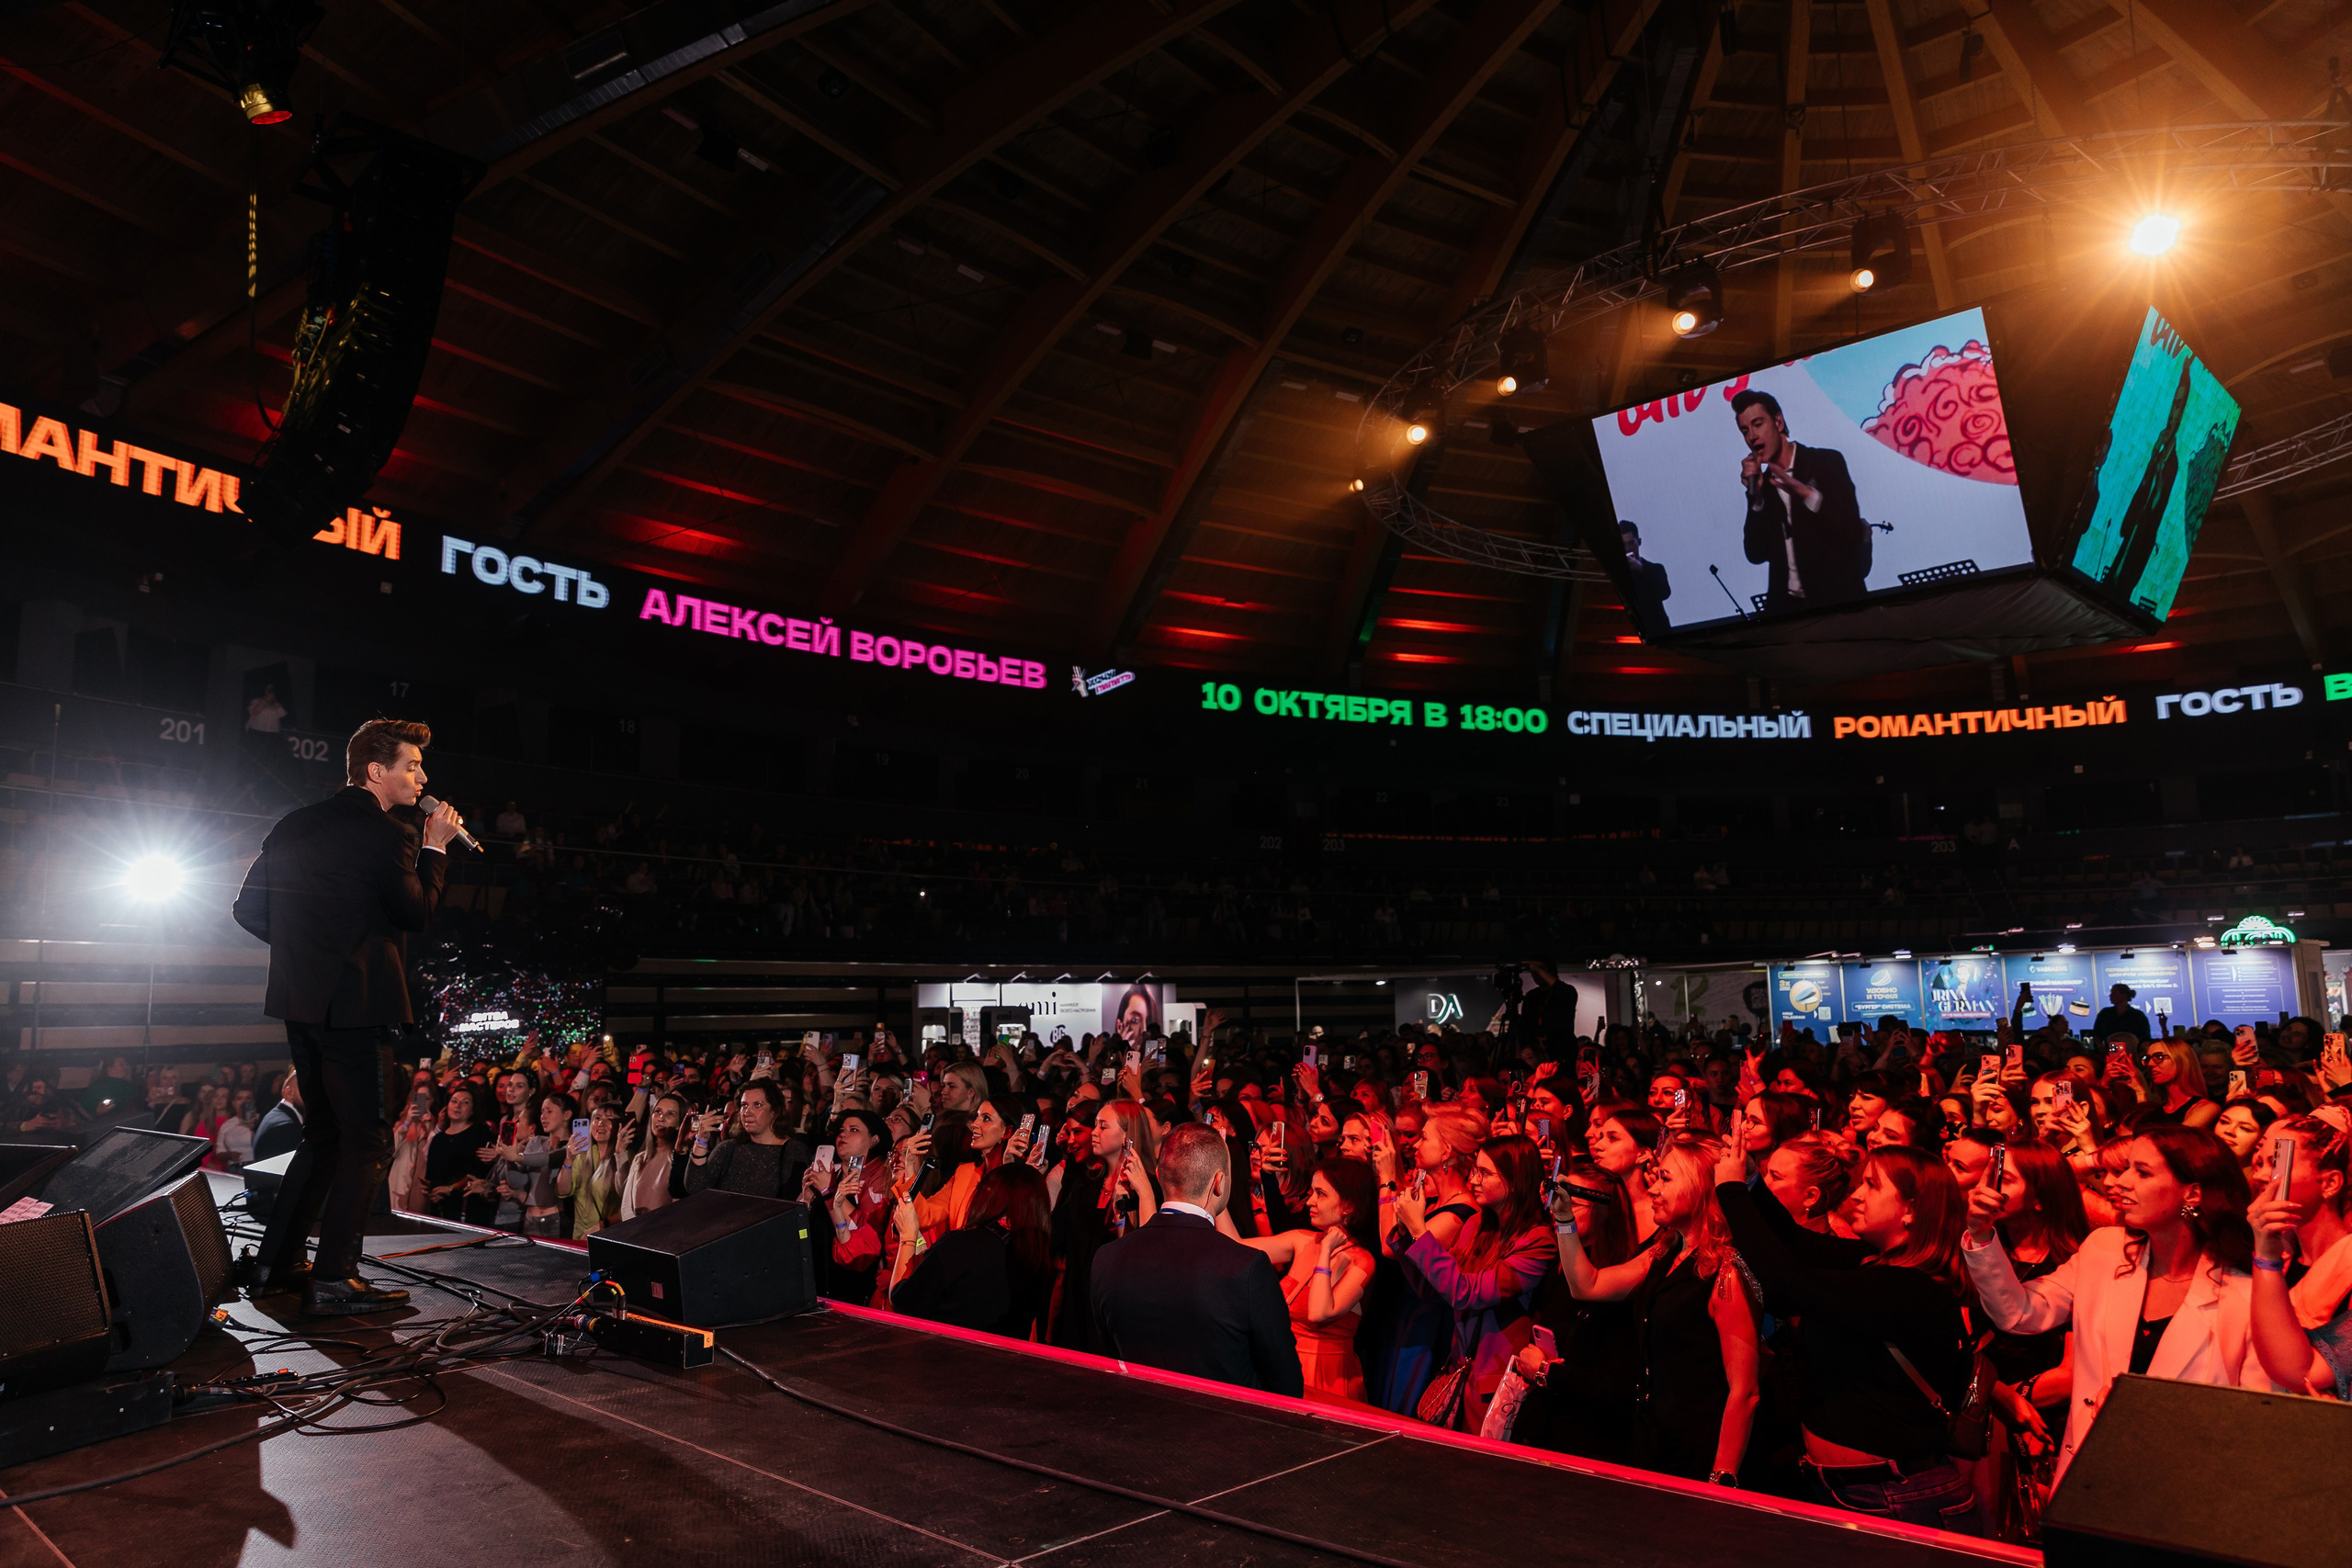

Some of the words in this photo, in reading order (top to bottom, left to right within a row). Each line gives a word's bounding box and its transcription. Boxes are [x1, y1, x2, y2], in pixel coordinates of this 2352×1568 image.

[441, 535, 610, 609] ГОСТЬ
[639, 587, 842, 658] АЛЕКСЕЙ
[850, 629, 1047, 689] ВОРОБЬЕВ
[390, 681, 410, 698] 17
[1202, 682, 1241, 711] 10
[1254, 687, 1412, 726] ОКТЯБРЯ
[1424, 702, 1448, 727] В
[1460, 704, 1548, 734] 18:00
[1566, 710, 1812, 742] СПЕЦИАЛЬНЫЙ
[1833, 695, 2128, 739] РОМАНТИЧНЫЙ
[2155, 682, 2303, 720] ГОСТЬ
[159, 717, 206, 745] 201
[618, 718, 636, 734] 18
[288, 737, 329, 761] 202
[1260, 836, 1282, 850] 202
[1323, 839, 1346, 852] 203
[1931, 840, 1956, 853] 203
